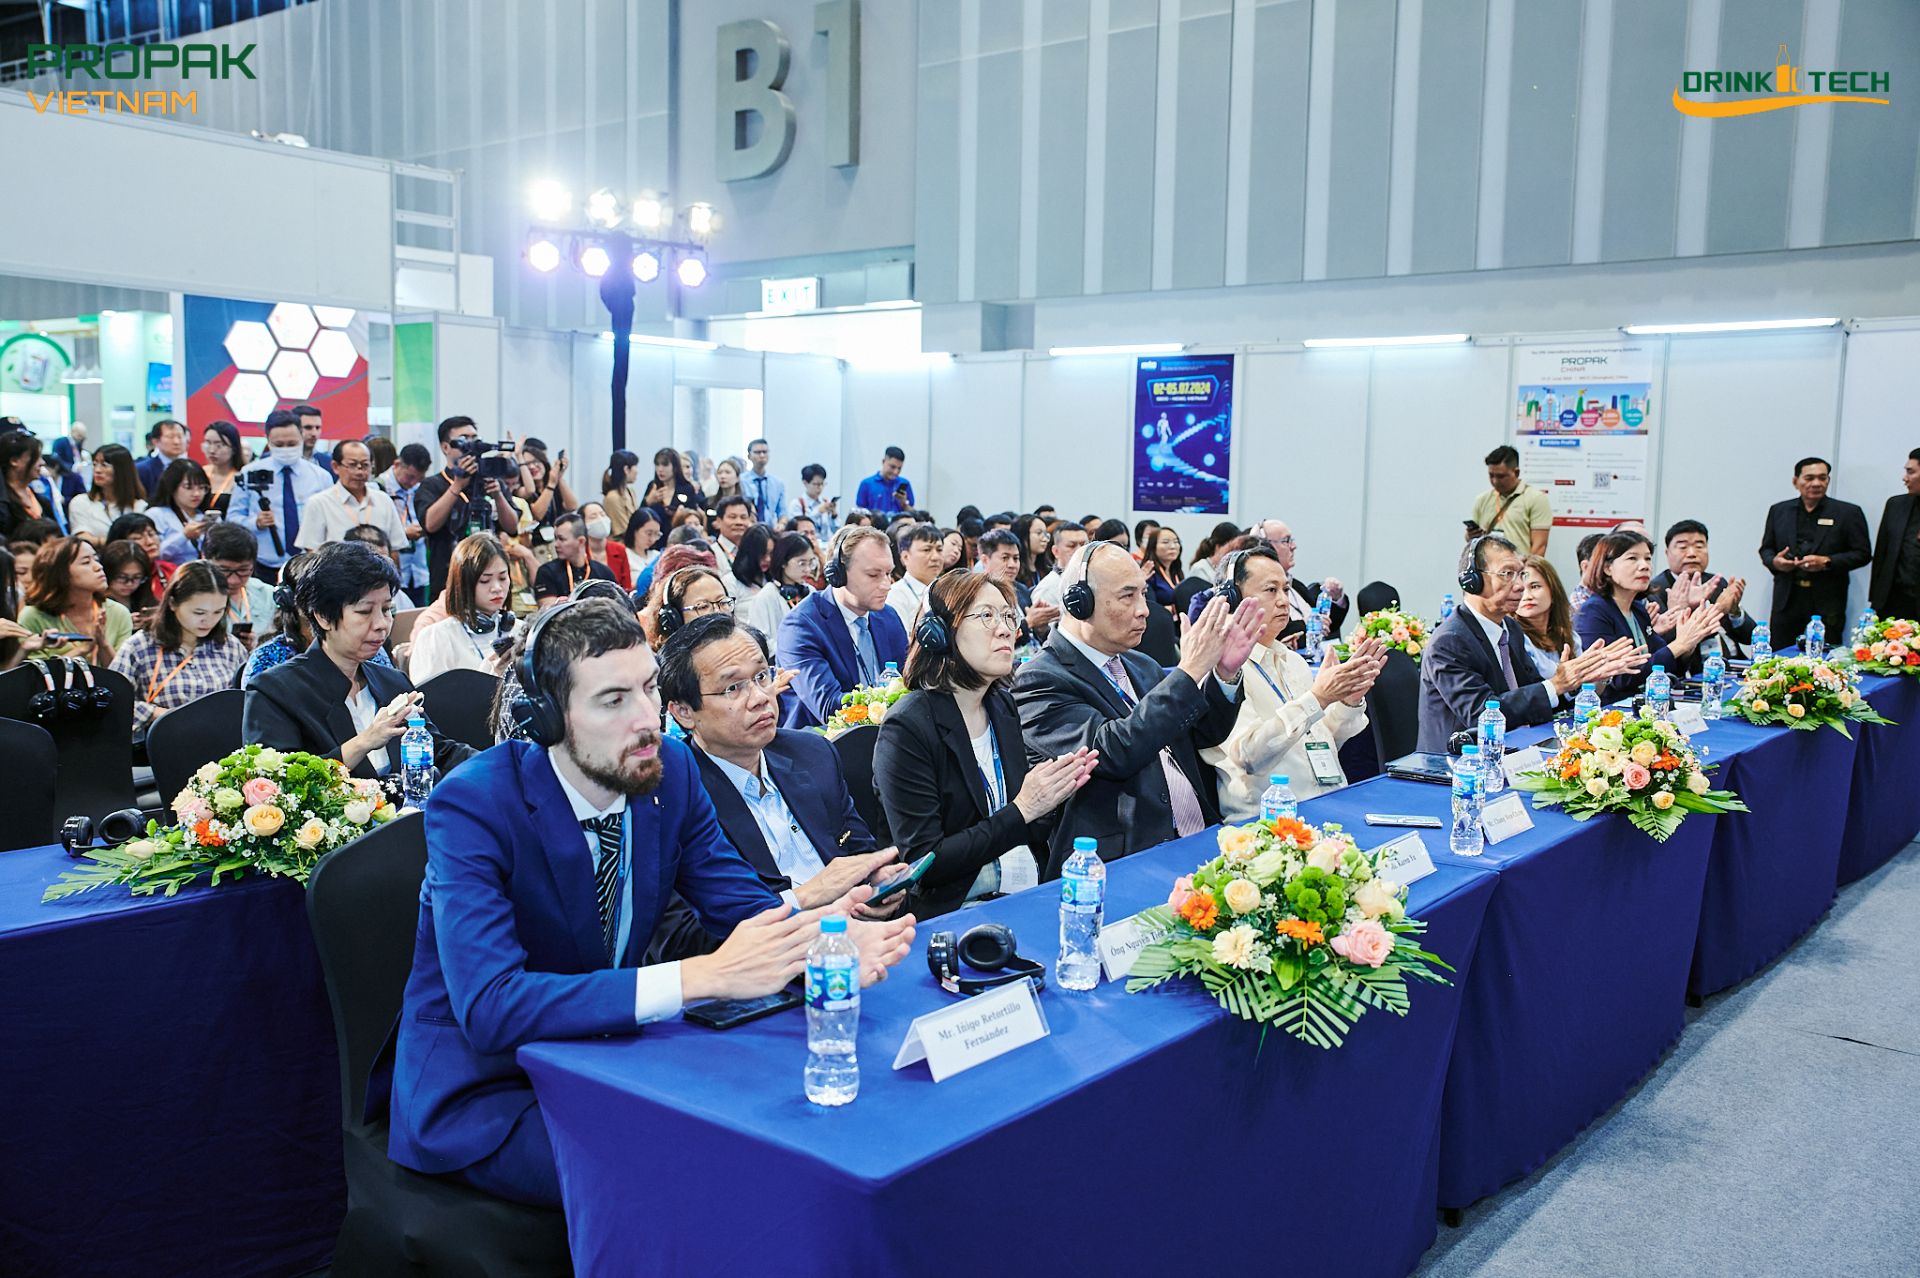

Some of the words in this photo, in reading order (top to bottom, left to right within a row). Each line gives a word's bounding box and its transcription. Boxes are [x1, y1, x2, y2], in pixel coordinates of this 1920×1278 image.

[716, 0, 861, 182] B1
[767, 286, 811, 304] EXIT
[1561, 356, 1608, 365] PROPAK
[938, 1029, 956, 1040] Mr.
[981, 1002, 1021, 1024] Retortillo
